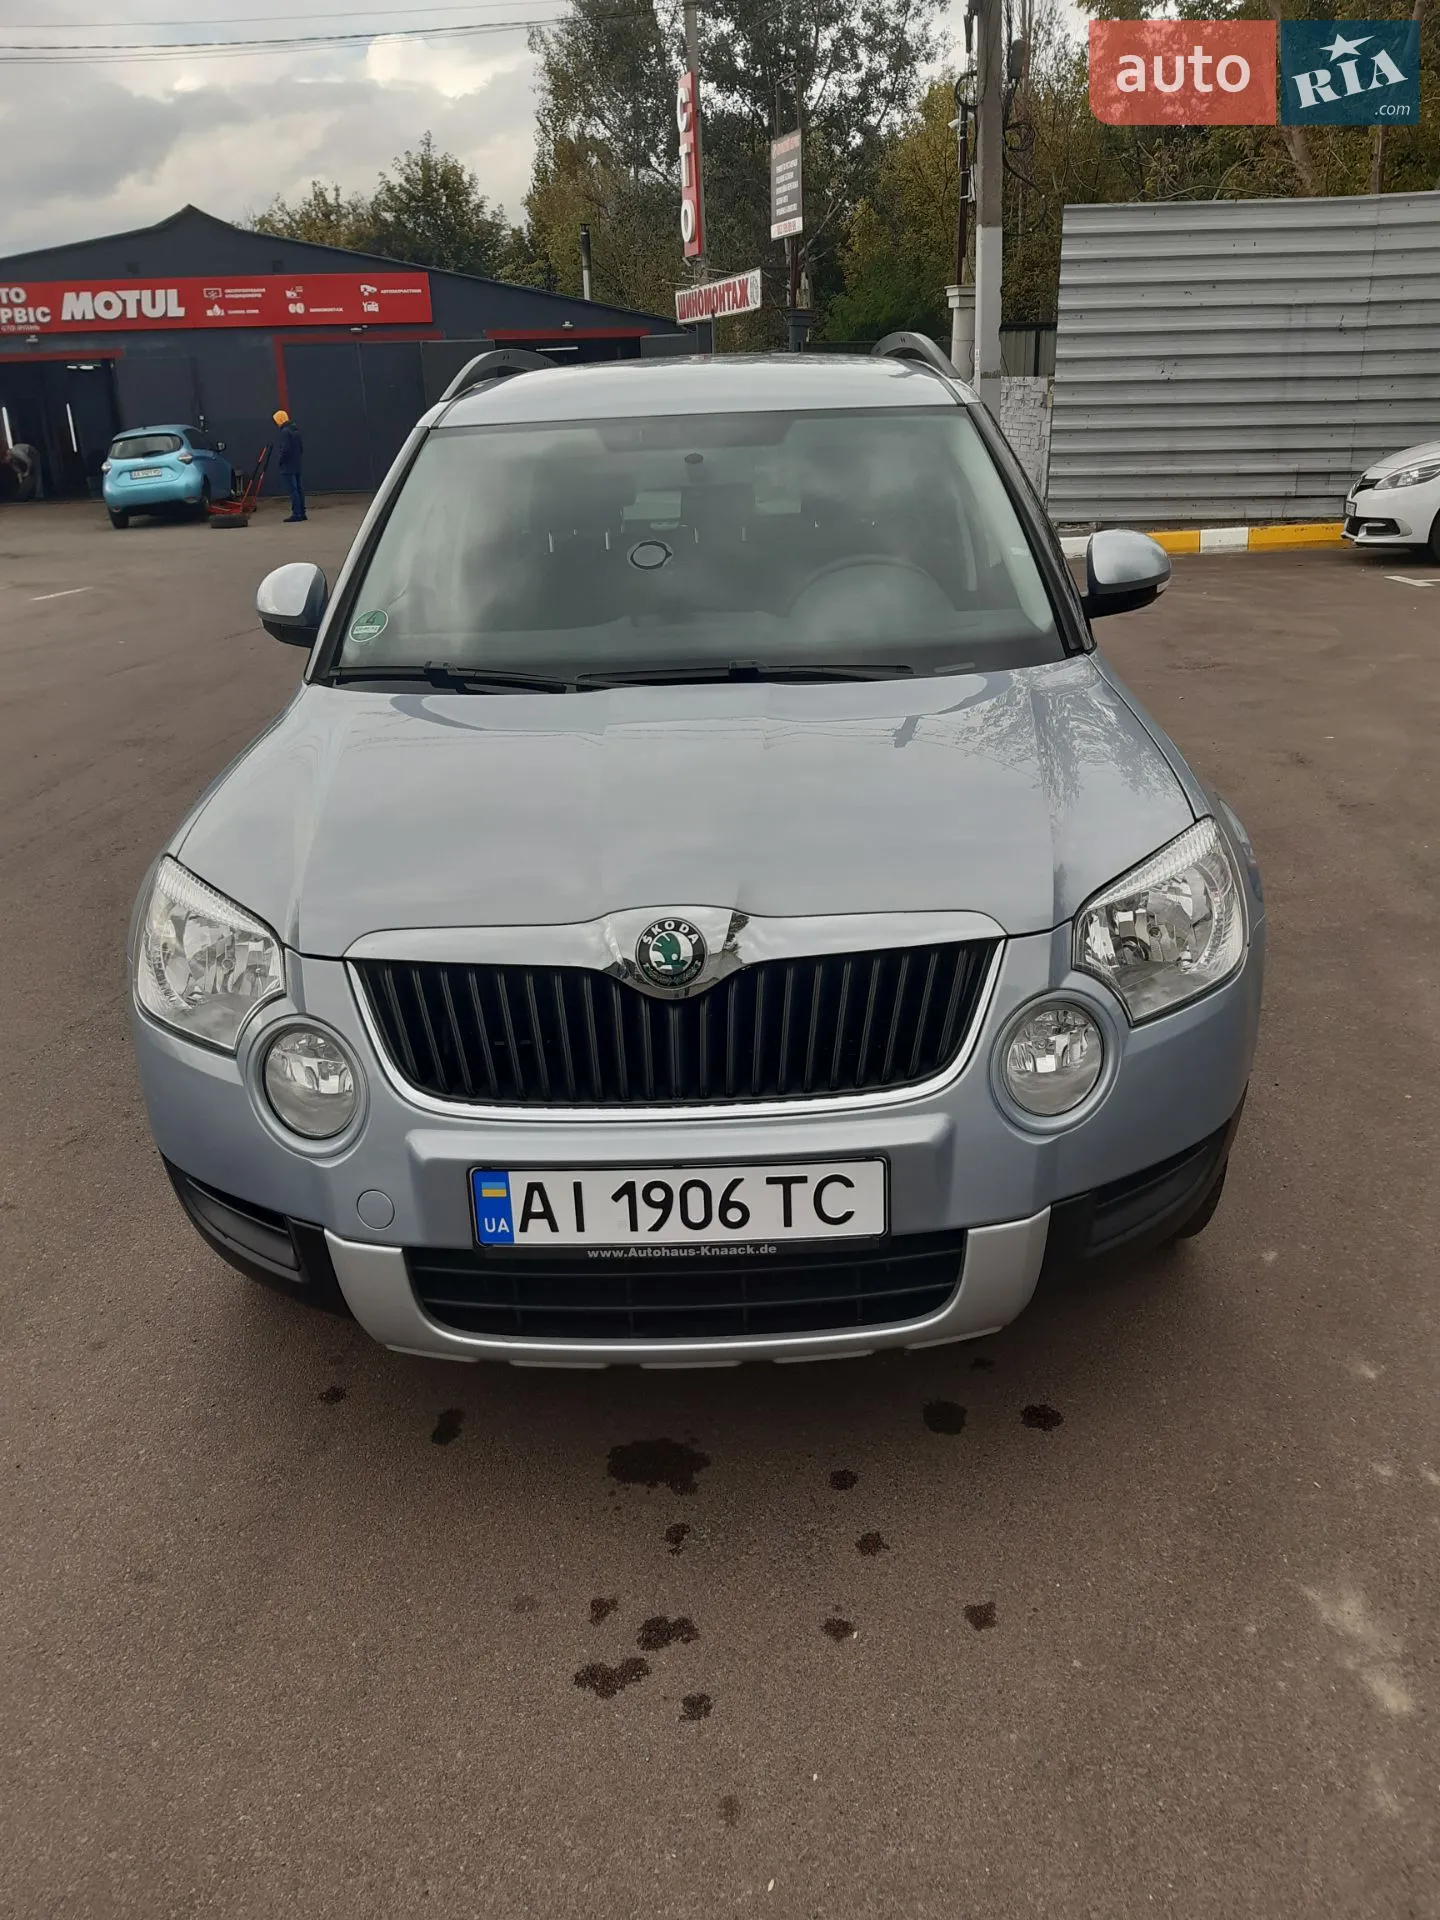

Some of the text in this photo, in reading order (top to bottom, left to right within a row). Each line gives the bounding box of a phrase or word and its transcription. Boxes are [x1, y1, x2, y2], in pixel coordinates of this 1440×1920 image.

[677, 87, 695, 243] СТО
[61, 289, 185, 320] MOTUL
[677, 277, 750, 320] ШИНОМОНТАЖ
[519, 1173, 855, 1233] AI 1906 TC
[484, 1217, 510, 1233] UA
[587, 1243, 777, 1258] www.Autohaus-Knaack.de
